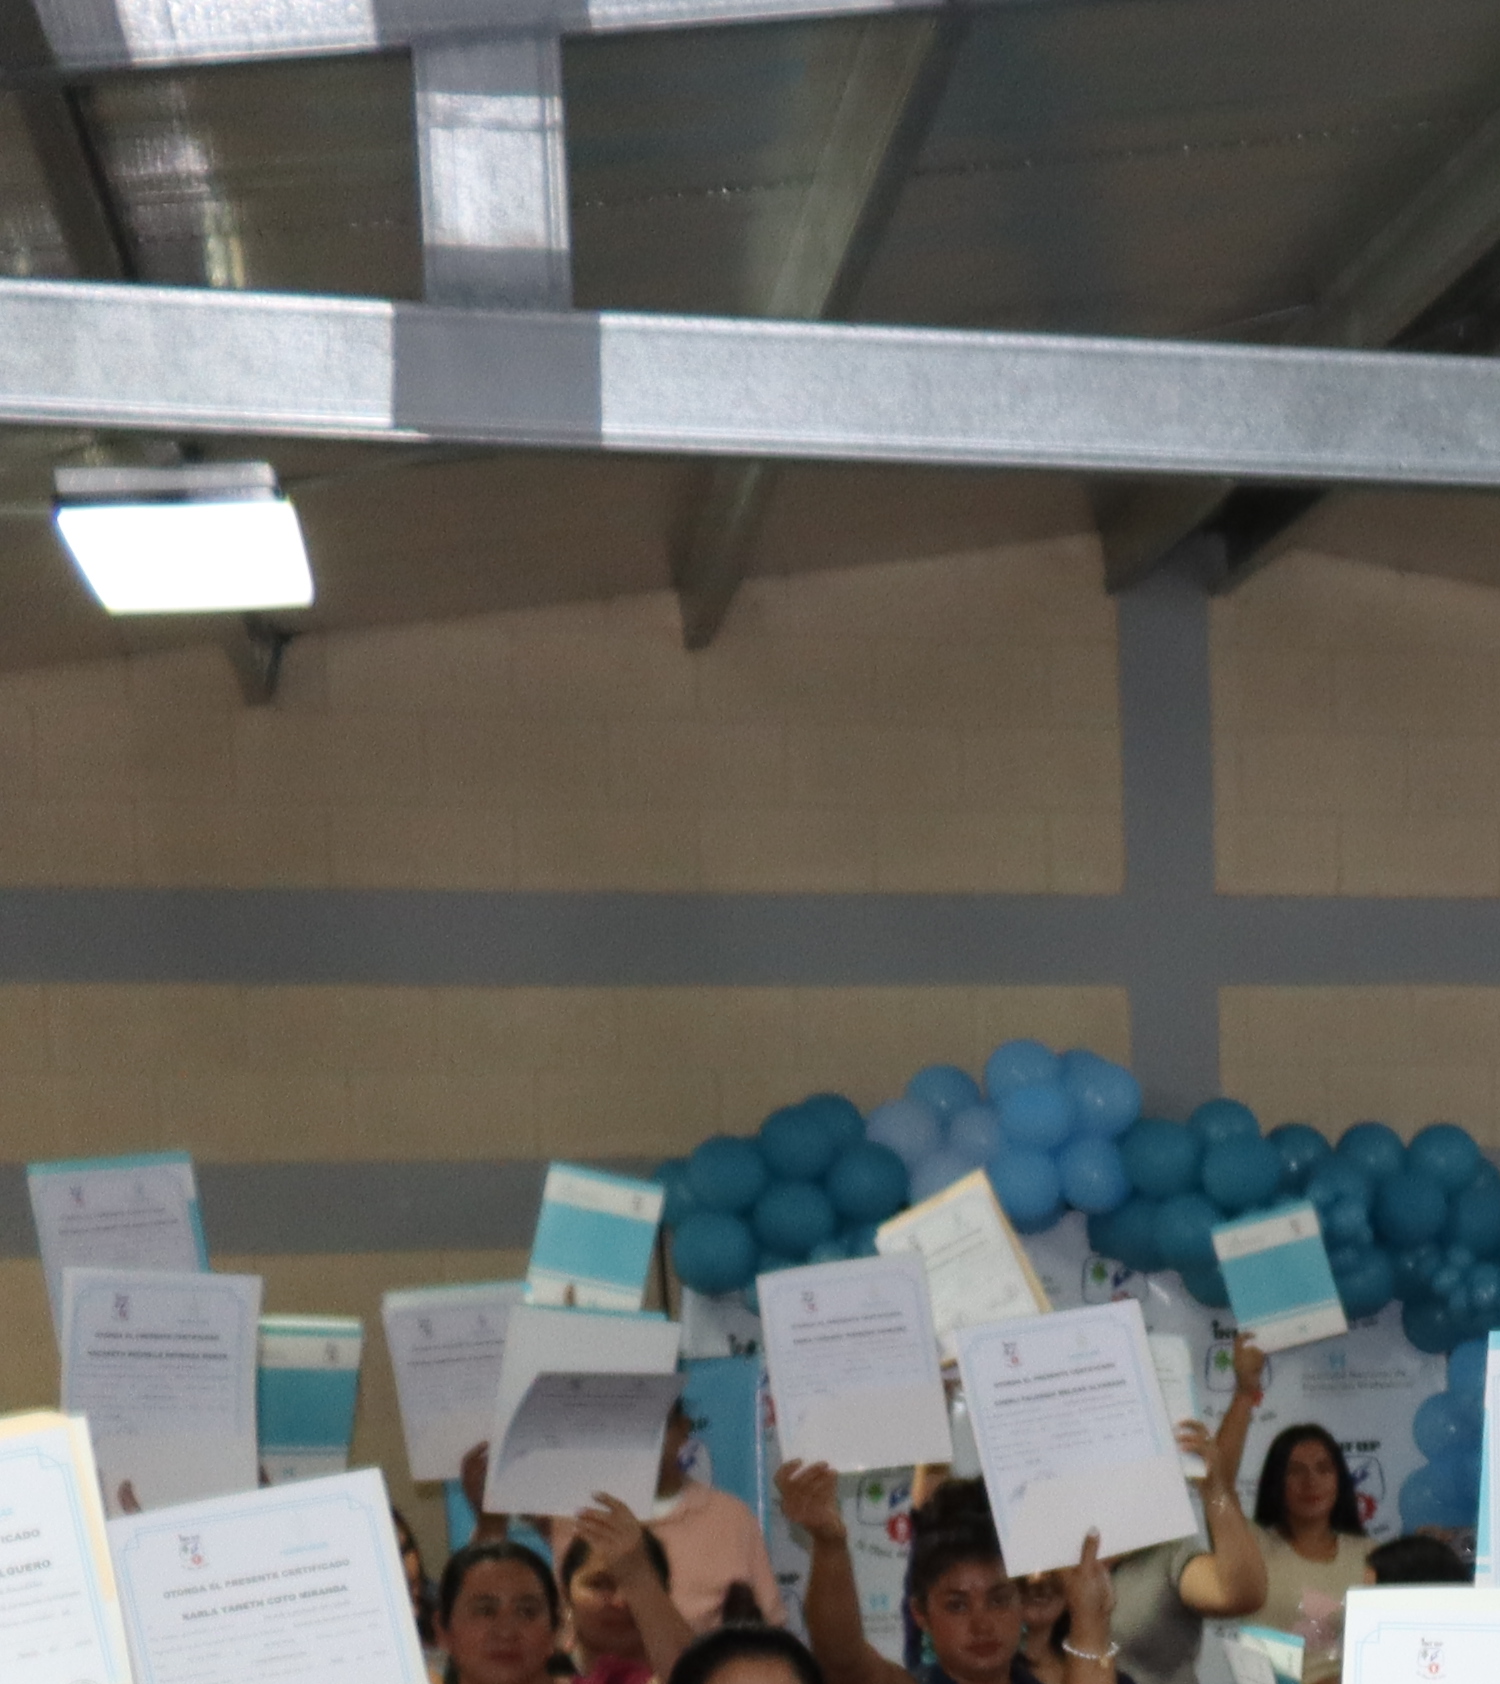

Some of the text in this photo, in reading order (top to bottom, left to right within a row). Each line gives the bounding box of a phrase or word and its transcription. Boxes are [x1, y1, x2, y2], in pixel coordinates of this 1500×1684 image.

[163, 1558, 350, 1600] OTORGA EL PRESENTE CERTIFICADO
[182, 1608, 219, 1622] KARLA
[299, 1584, 349, 1600] MIRANDA
